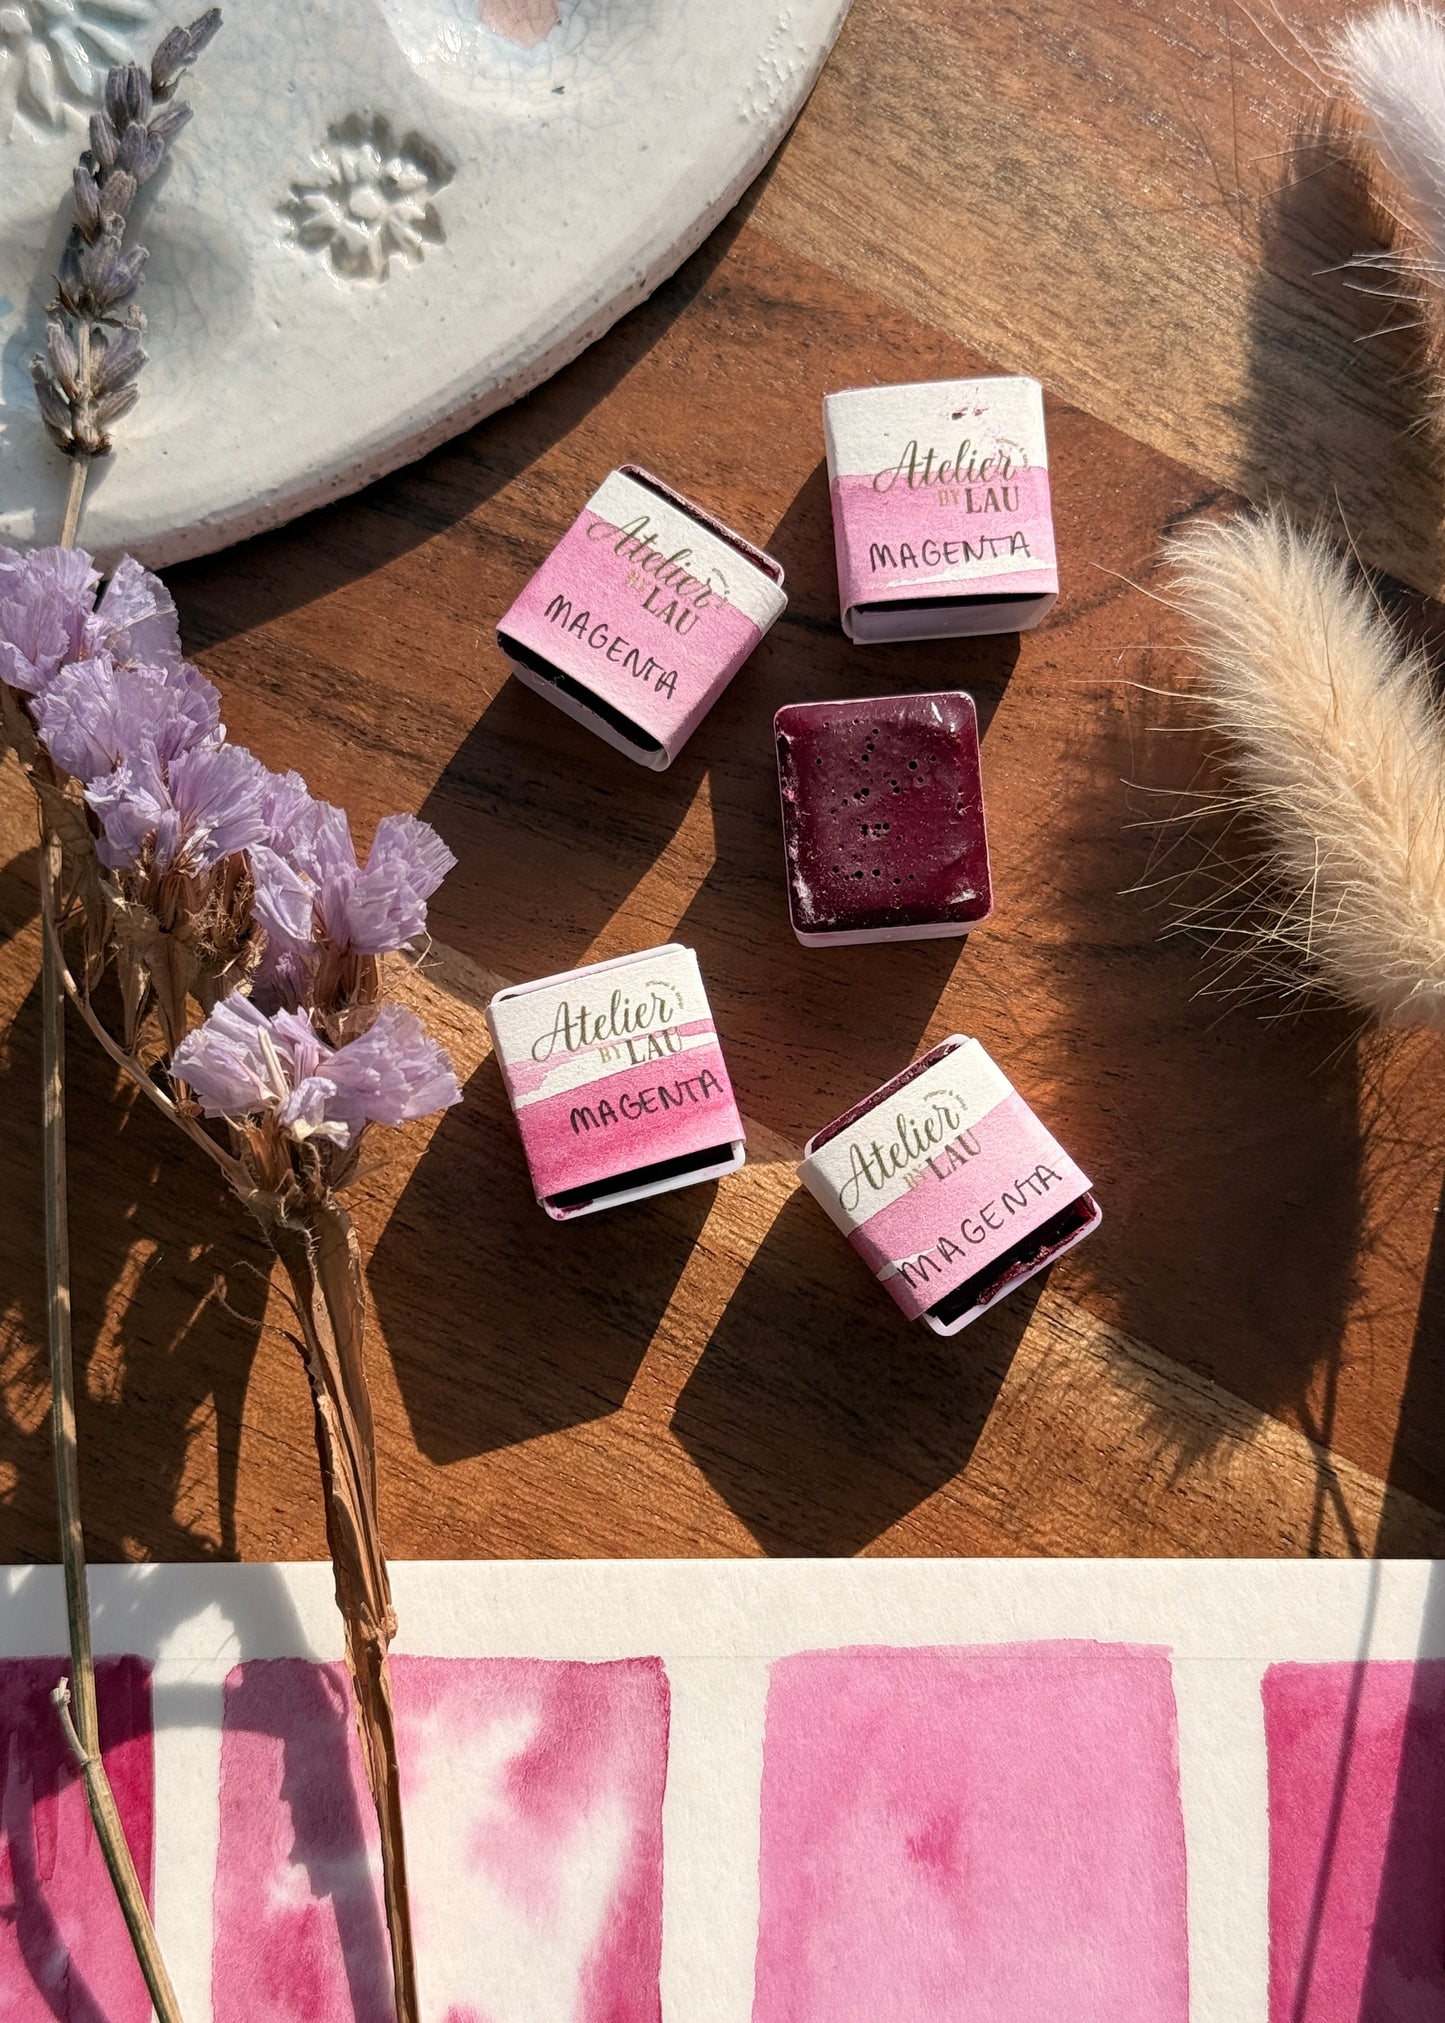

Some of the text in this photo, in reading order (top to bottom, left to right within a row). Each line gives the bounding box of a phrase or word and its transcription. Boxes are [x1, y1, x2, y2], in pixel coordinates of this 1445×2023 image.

[873, 439, 1016, 493] Atelier
[965, 486, 1019, 514] LAU
[587, 516, 712, 609] Atelier
[869, 531, 1030, 572] MAGENTA
[641, 587, 698, 635] LAU
[543, 594, 678, 700] MAGENTA
[531, 989, 674, 1062] Atelier
[600, 1026, 682, 1066] BY LAU
[570, 1069, 724, 1134] MAGENTA
[839, 1104, 960, 1211] Atelier
[925, 1128, 982, 1182] LAU
[896, 1164, 1062, 1289] MAGENTA
